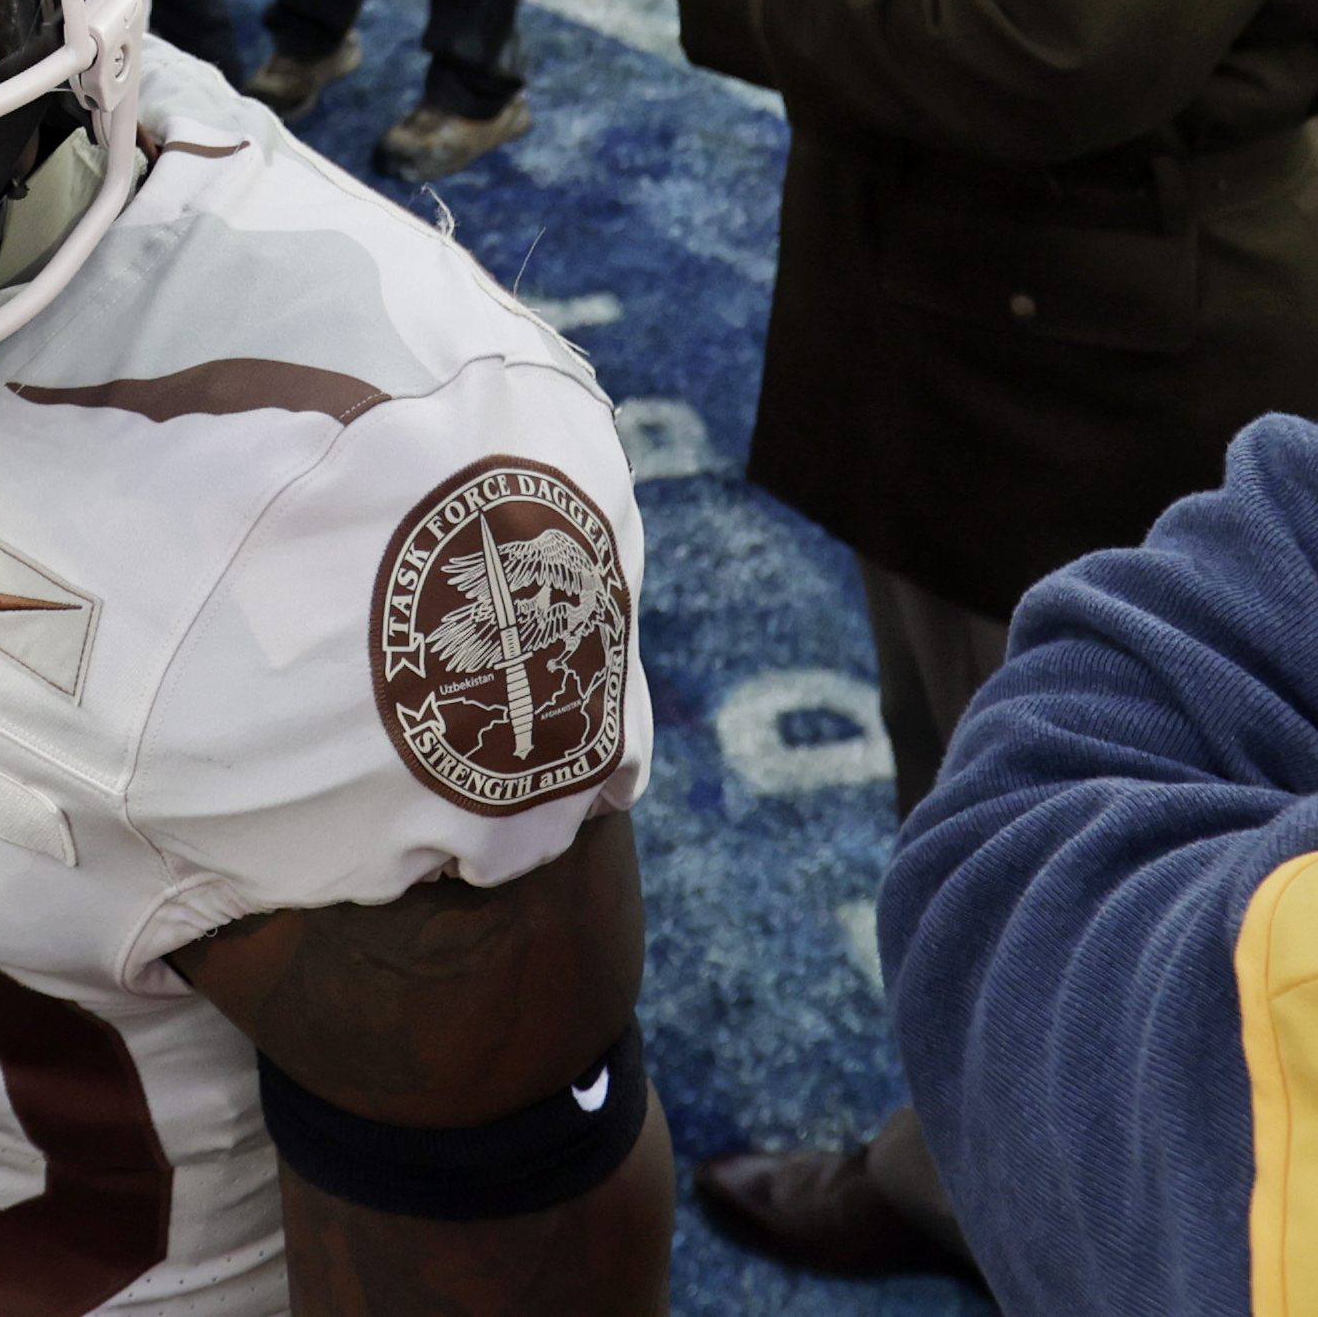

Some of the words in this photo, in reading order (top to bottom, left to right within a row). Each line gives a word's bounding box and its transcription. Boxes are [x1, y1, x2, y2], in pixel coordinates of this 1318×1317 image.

[389, 547, 432, 639] TASK
[426, 473, 512, 542] FORCE
[518, 474, 615, 570] DAGGER
[417, 729, 533, 799] STRENGTH
[540, 758, 590, 788] and
[596, 647, 624, 766] HONOR
[439, 673, 495, 695] Uzbekistan
